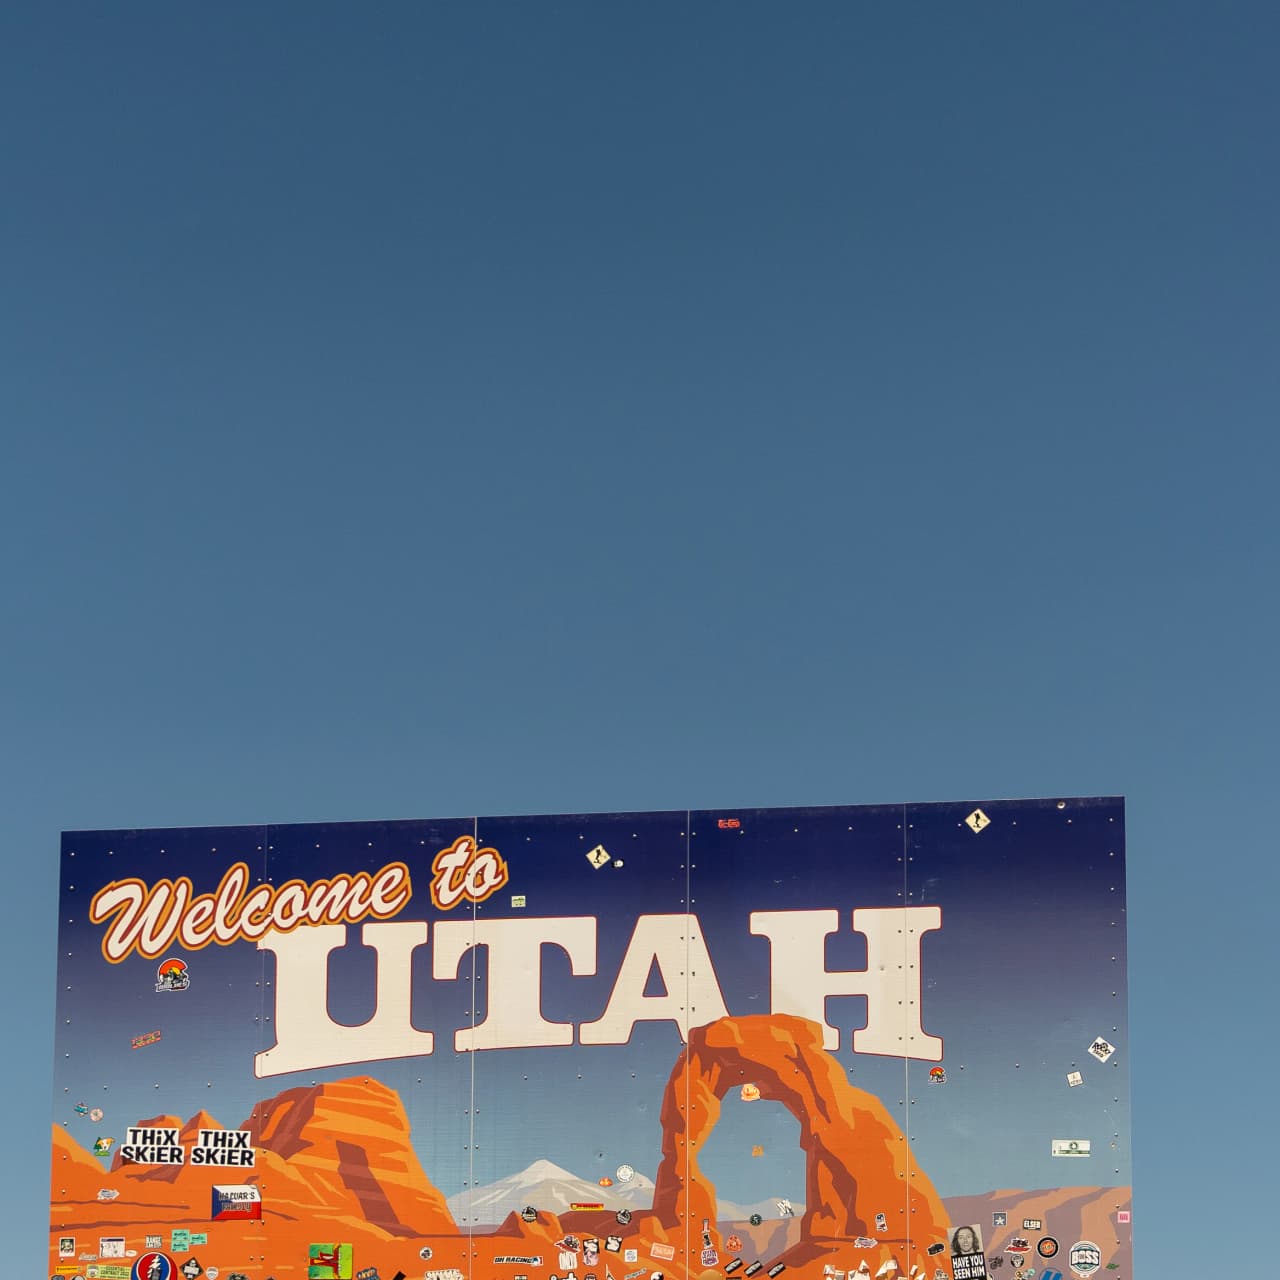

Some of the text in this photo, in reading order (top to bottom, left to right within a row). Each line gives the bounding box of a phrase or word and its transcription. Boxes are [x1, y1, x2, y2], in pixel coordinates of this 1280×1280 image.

[90, 836, 508, 963] Welcome to
[254, 906, 945, 1079] UTAH
[953, 1255, 984, 1269] HAVE YOU
[1071, 1250, 1099, 1265] BOSS
[954, 1266, 986, 1280] SEEN HIM
